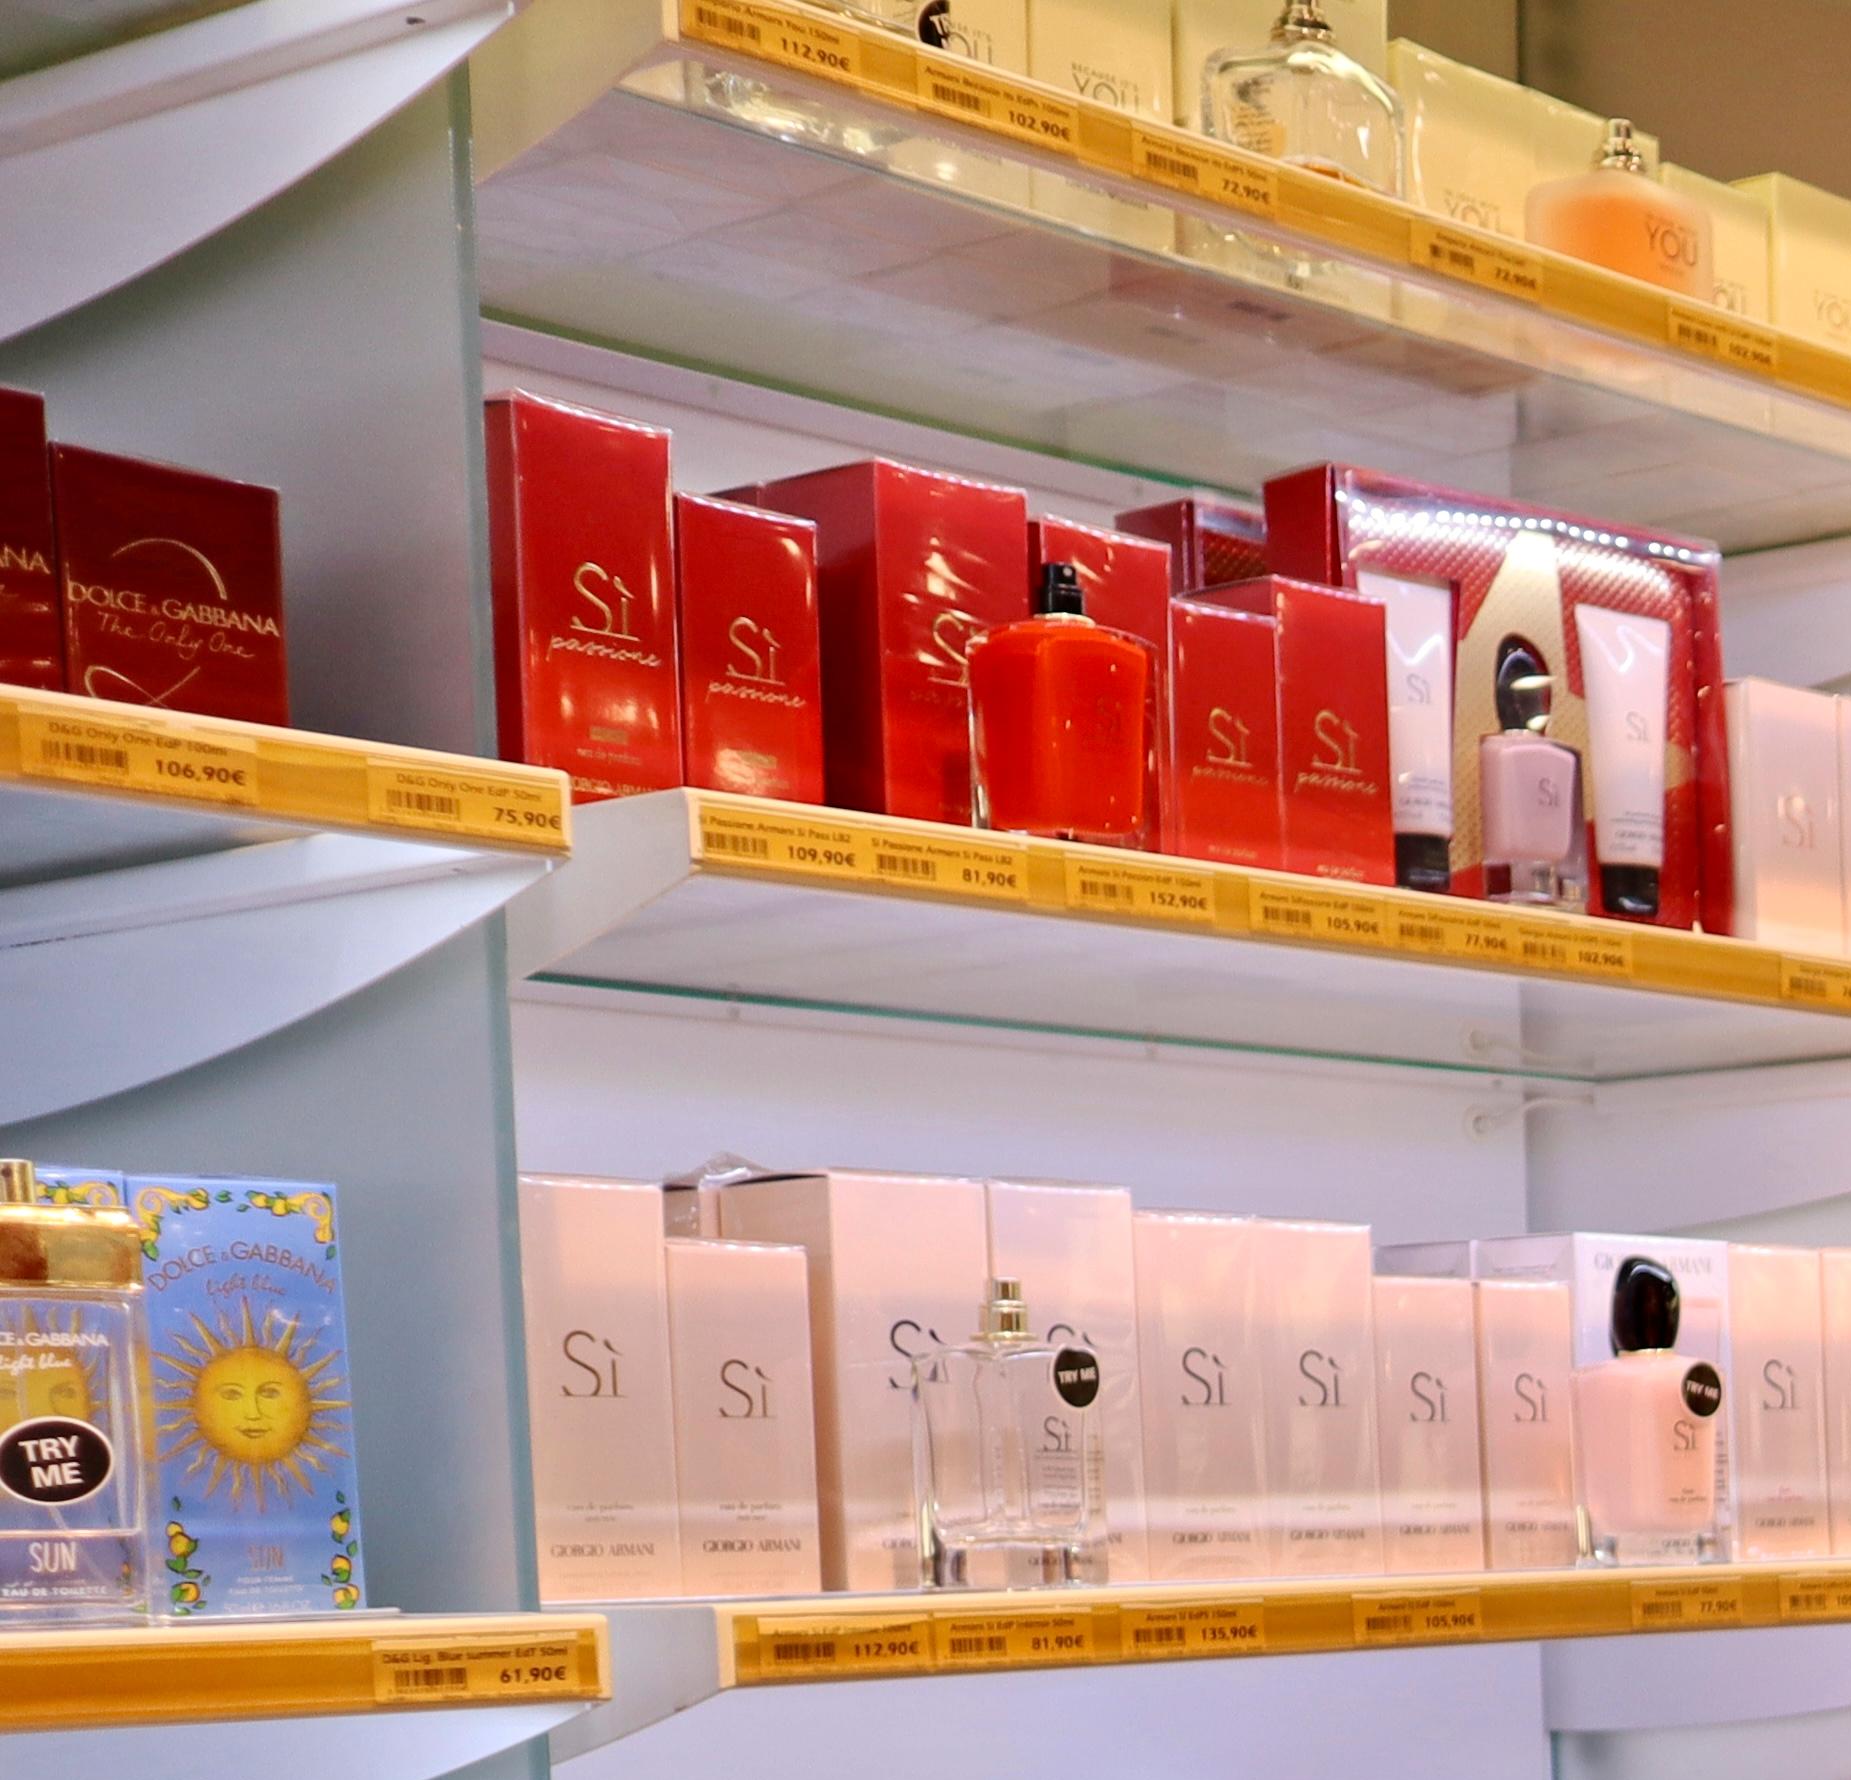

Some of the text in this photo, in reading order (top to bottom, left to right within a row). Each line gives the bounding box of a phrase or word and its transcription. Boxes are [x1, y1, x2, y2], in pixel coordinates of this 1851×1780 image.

[1645, 219, 1698, 267] YOU
[570, 560, 641, 642] Sì
[98, 610, 256, 661] The Only One
[546, 633, 663, 669] passione
[725, 615, 786, 686] Sì
[704, 679, 807, 709] passione
[1294, 770, 1379, 796] passione
[492, 806, 563, 831] 75,90€
[786, 844, 856, 868] 109,90€
[962, 867, 1018, 890] 81,90€
[561, 1330, 627, 1398] Sì
[1057, 1366, 1097, 1385] TRY ME
[1181, 1346, 1231, 1407] Sì
[1298, 1349, 1347, 1407] Sì
[718, 1358, 777, 1419] Sì
[1409, 1370, 1450, 1423] Sì
[1513, 1372, 1551, 1423] Sì
[1685, 1379, 1704, 1397] TRY
[1762, 1358, 1799, 1412] Sì
[18, 1434, 80, 1463] TRY
[1041, 1415, 1073, 1453] Sì
[1672, 1418, 1698, 1452] Sì
[29, 1459, 85, 1489] ME
[28, 1541, 78, 1574] SUN
[247, 1544, 285, 1571] SUN
[550, 1543, 655, 1558] GIORGIO ARMANI
[702, 1538, 803, 1553] GIORGIO ARMANI
[1030, 1635, 1086, 1653] 81,90€
[1200, 1623, 1258, 1642] 135,90€
[499, 1665, 567, 1685] 61,90€
